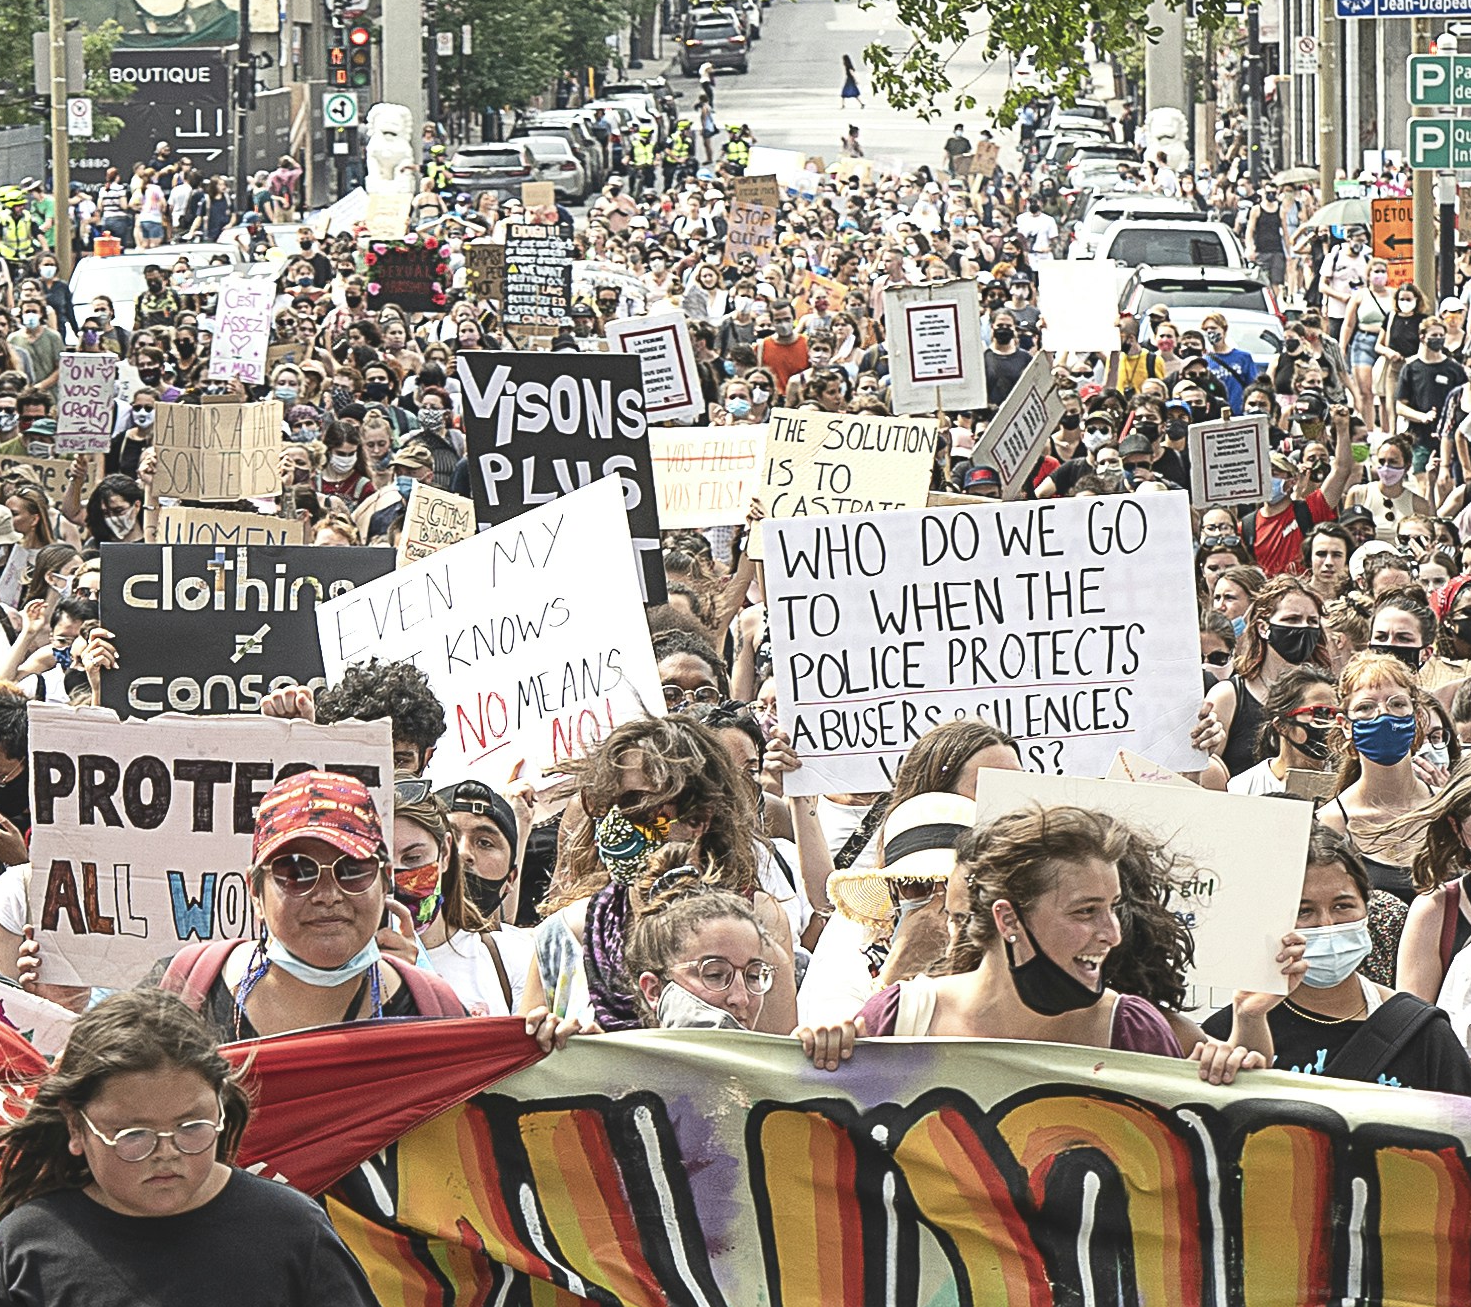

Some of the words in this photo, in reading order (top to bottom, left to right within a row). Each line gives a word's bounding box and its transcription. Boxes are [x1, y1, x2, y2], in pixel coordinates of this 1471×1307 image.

[109, 67, 211, 84] BOUTIQUE
[1415, 63, 1446, 100] P
[1415, 125, 1446, 163] P
[63, 384, 100, 398] VOUS
[159, 405, 176, 447] LA
[187, 406, 221, 451] PEUR
[773, 417, 808, 443] THE
[822, 420, 938, 454] SOLUTION
[159, 448, 206, 495] SON
[218, 448, 277, 497] TEMPS
[766, 458, 794, 487] IS
[813, 461, 851, 494] TO
[779, 521, 885, 581] WHO
[921, 510, 980, 563] DO
[995, 504, 1064, 560] WE
[1087, 498, 1148, 556] GO
[337, 565, 454, 660] EVEN
[492, 514, 565, 588] MY
[777, 590, 840, 642] TO
[870, 574, 1004, 638] WHEN
[1014, 565, 1106, 621] THE
[445, 596, 570, 674] KNOWS
[789, 637, 926, 703] POLICE
[949, 621, 1147, 686] PROTECTS
[457, 691, 508, 753] NO
[515, 648, 625, 730] MEANS
[791, 698, 941, 751] ABUSERS
[40, 858, 148, 938] ALL
